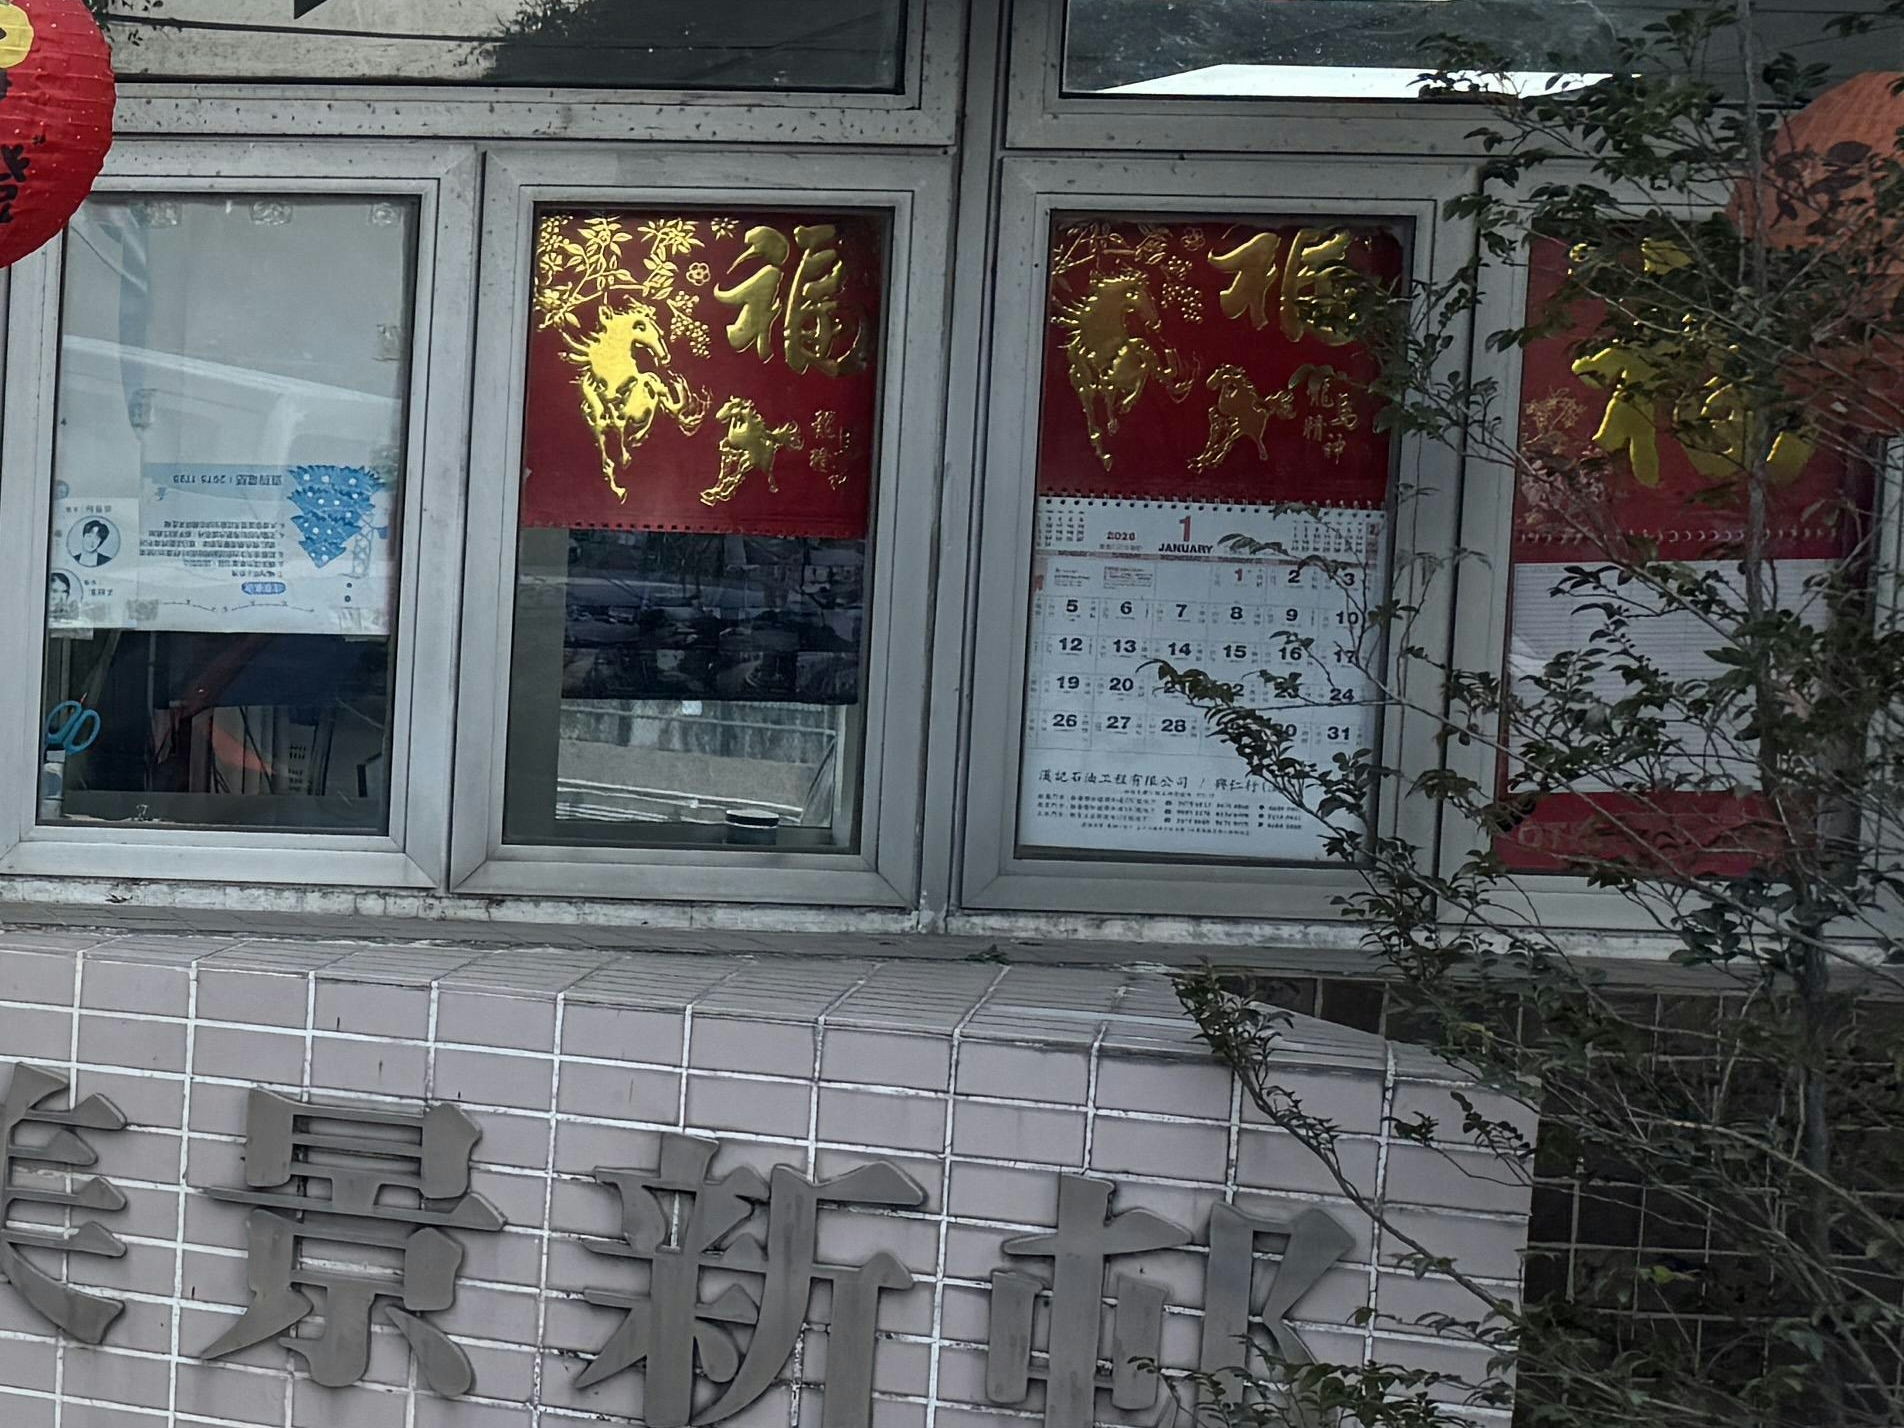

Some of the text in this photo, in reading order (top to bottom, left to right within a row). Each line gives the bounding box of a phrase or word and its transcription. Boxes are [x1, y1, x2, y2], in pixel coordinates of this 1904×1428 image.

[1158, 543, 1213, 554] JANUARY
[1288, 569, 1302, 584] 2
[1066, 599, 1359, 625] 5 6 7 8 9 10
[1059, 638, 1083, 652] 12
[1112, 639, 1137, 654] 13
[1168, 642, 1192, 657] 14
[1223, 645, 1247, 659] 15
[1278, 647, 1302, 661] 16
[1056, 676, 1080, 690] 19
[1109, 677, 1134, 692] 20
[1329, 688, 1354, 702] 24
[1052, 714, 1078, 729] 26
[1106, 716, 1131, 730] 27
[1161, 719, 1187, 733] 28
[1328, 727, 1351, 741] 31
